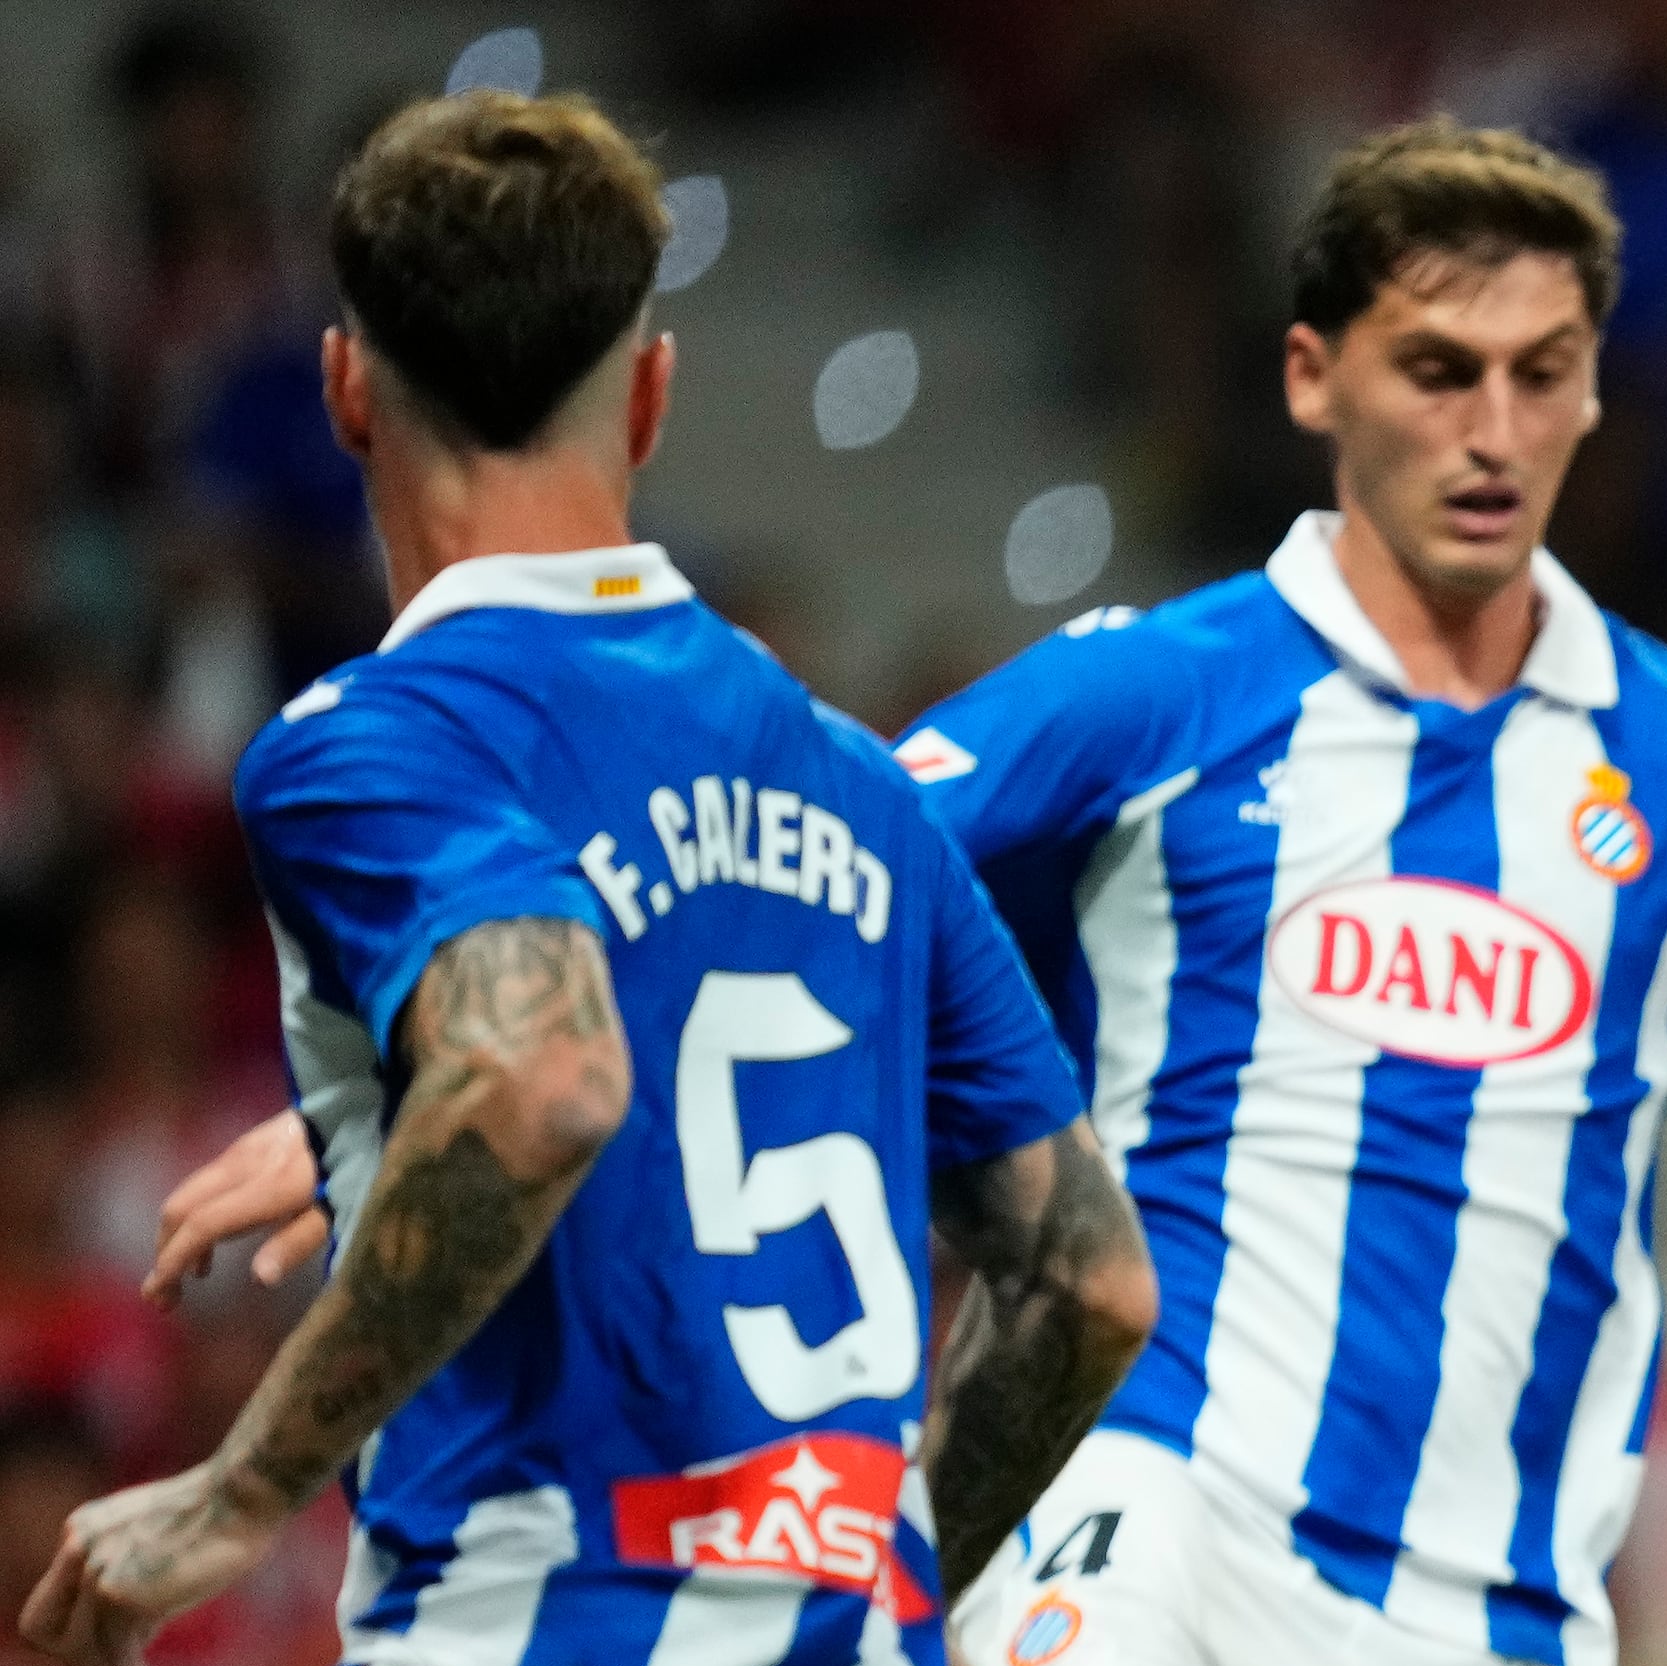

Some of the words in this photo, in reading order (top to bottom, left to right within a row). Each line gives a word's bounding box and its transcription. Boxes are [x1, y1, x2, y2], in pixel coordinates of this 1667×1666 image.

[648, 774, 893, 944] CALERO
[1310, 911, 1542, 1031] DANI
[675, 970, 922, 1423] 5
